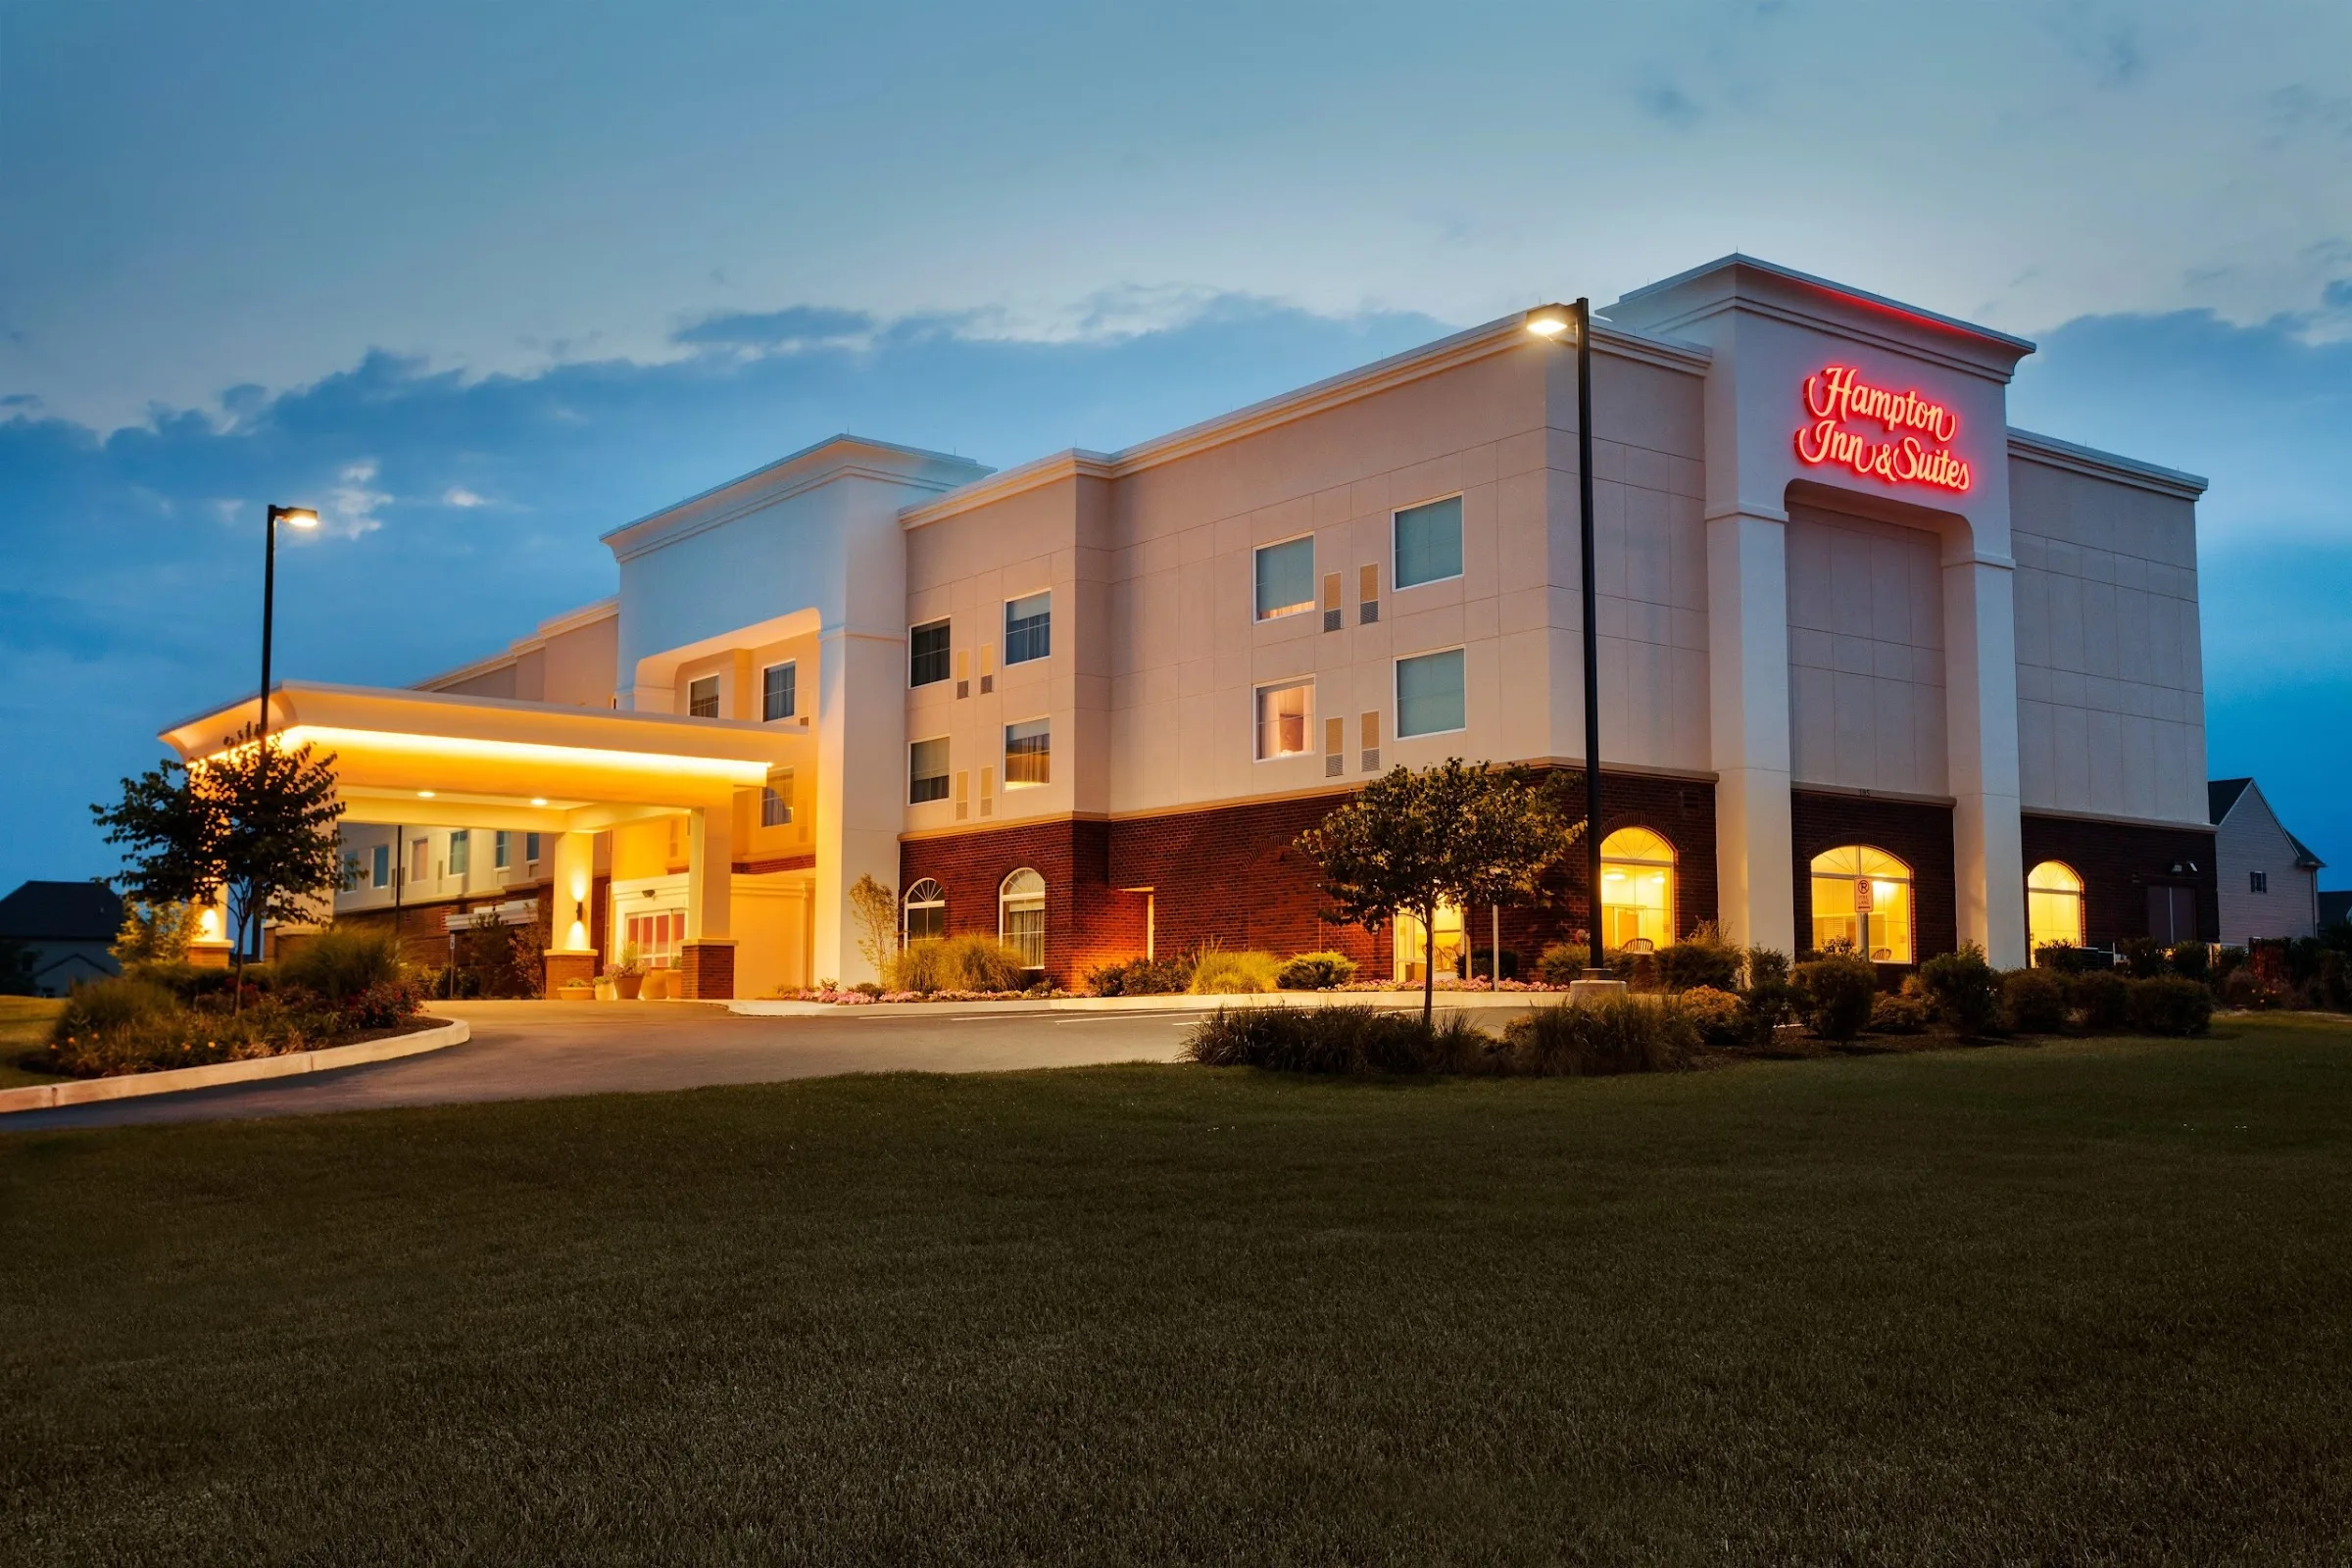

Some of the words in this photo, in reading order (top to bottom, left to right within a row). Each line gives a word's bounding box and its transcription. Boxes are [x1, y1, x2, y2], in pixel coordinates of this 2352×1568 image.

[1805, 367, 1956, 443] Hampton
[1796, 419, 1877, 473] Inn
[1892, 436, 1971, 491] Suites
